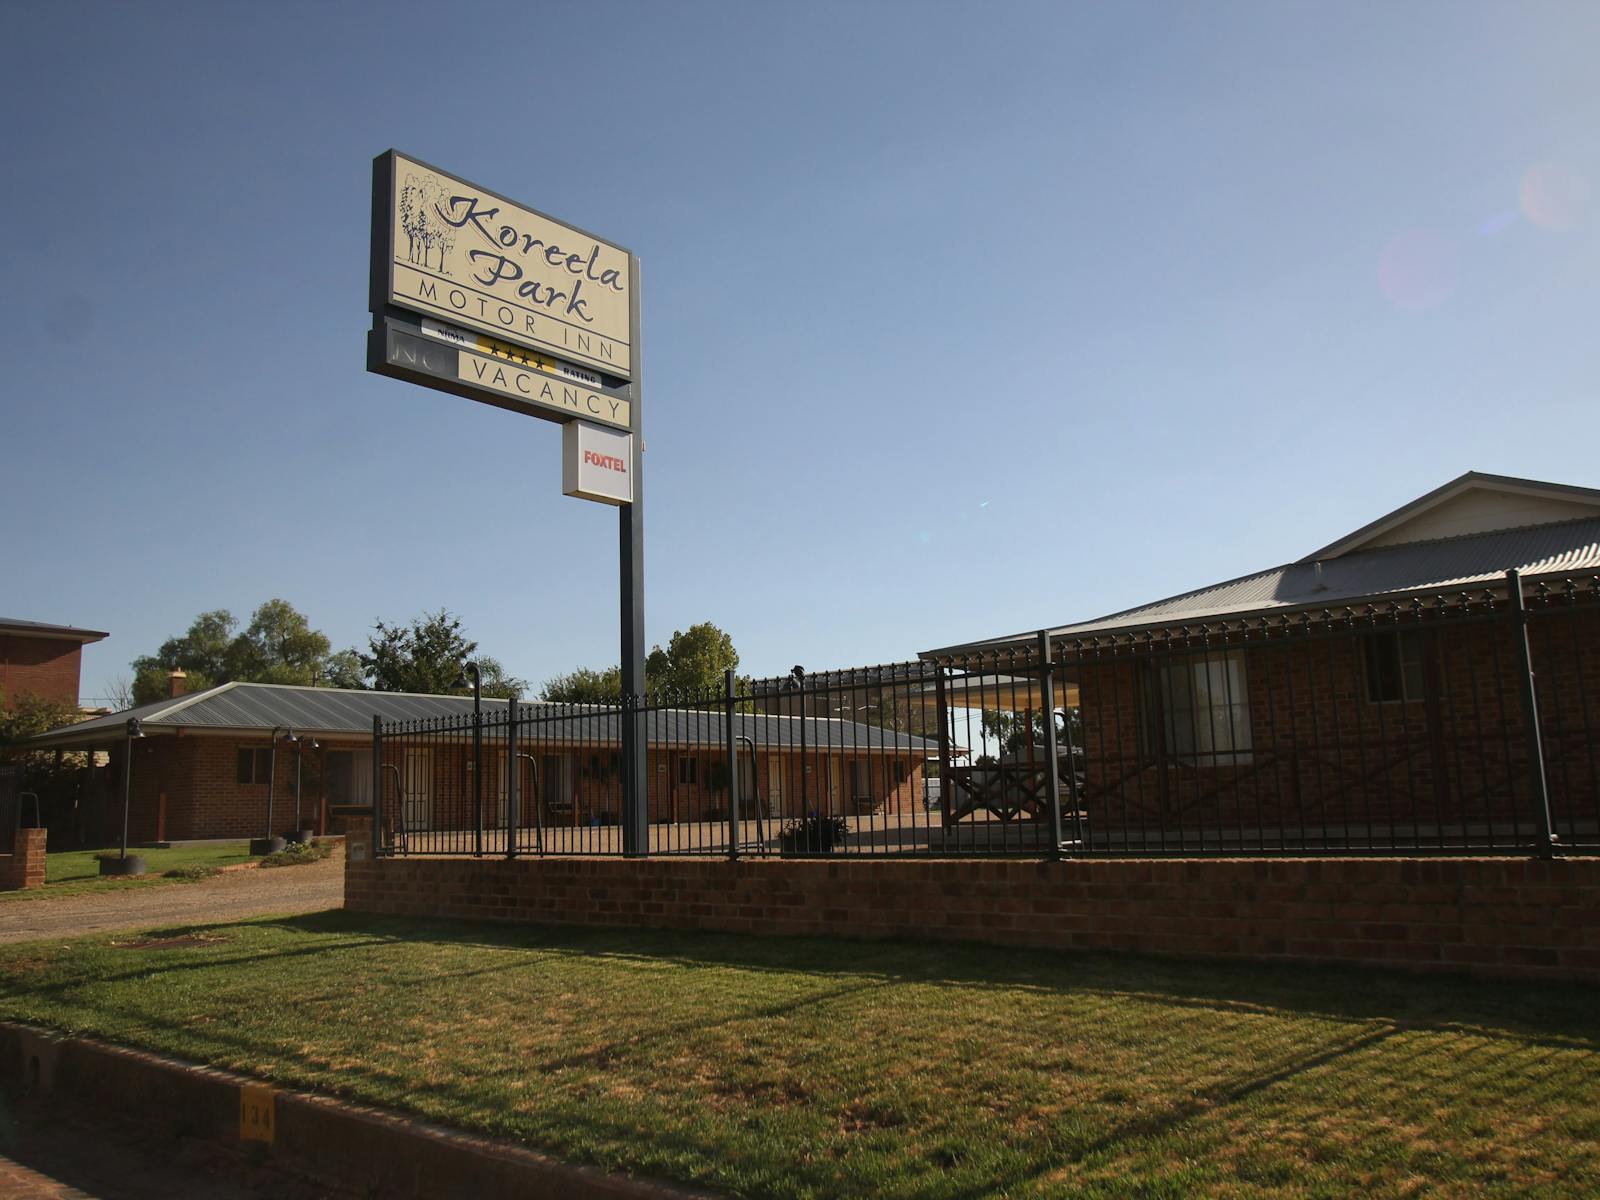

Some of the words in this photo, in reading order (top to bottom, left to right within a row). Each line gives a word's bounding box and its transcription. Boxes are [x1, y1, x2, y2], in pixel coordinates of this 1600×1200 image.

[434, 196, 624, 291] Koreela
[418, 278, 536, 335] MOTOR
[563, 327, 613, 360] INN
[469, 249, 594, 323] Park
[472, 358, 620, 419] VACANCY
[563, 366, 597, 384] RATING
[583, 449, 627, 474] FOXTEL
